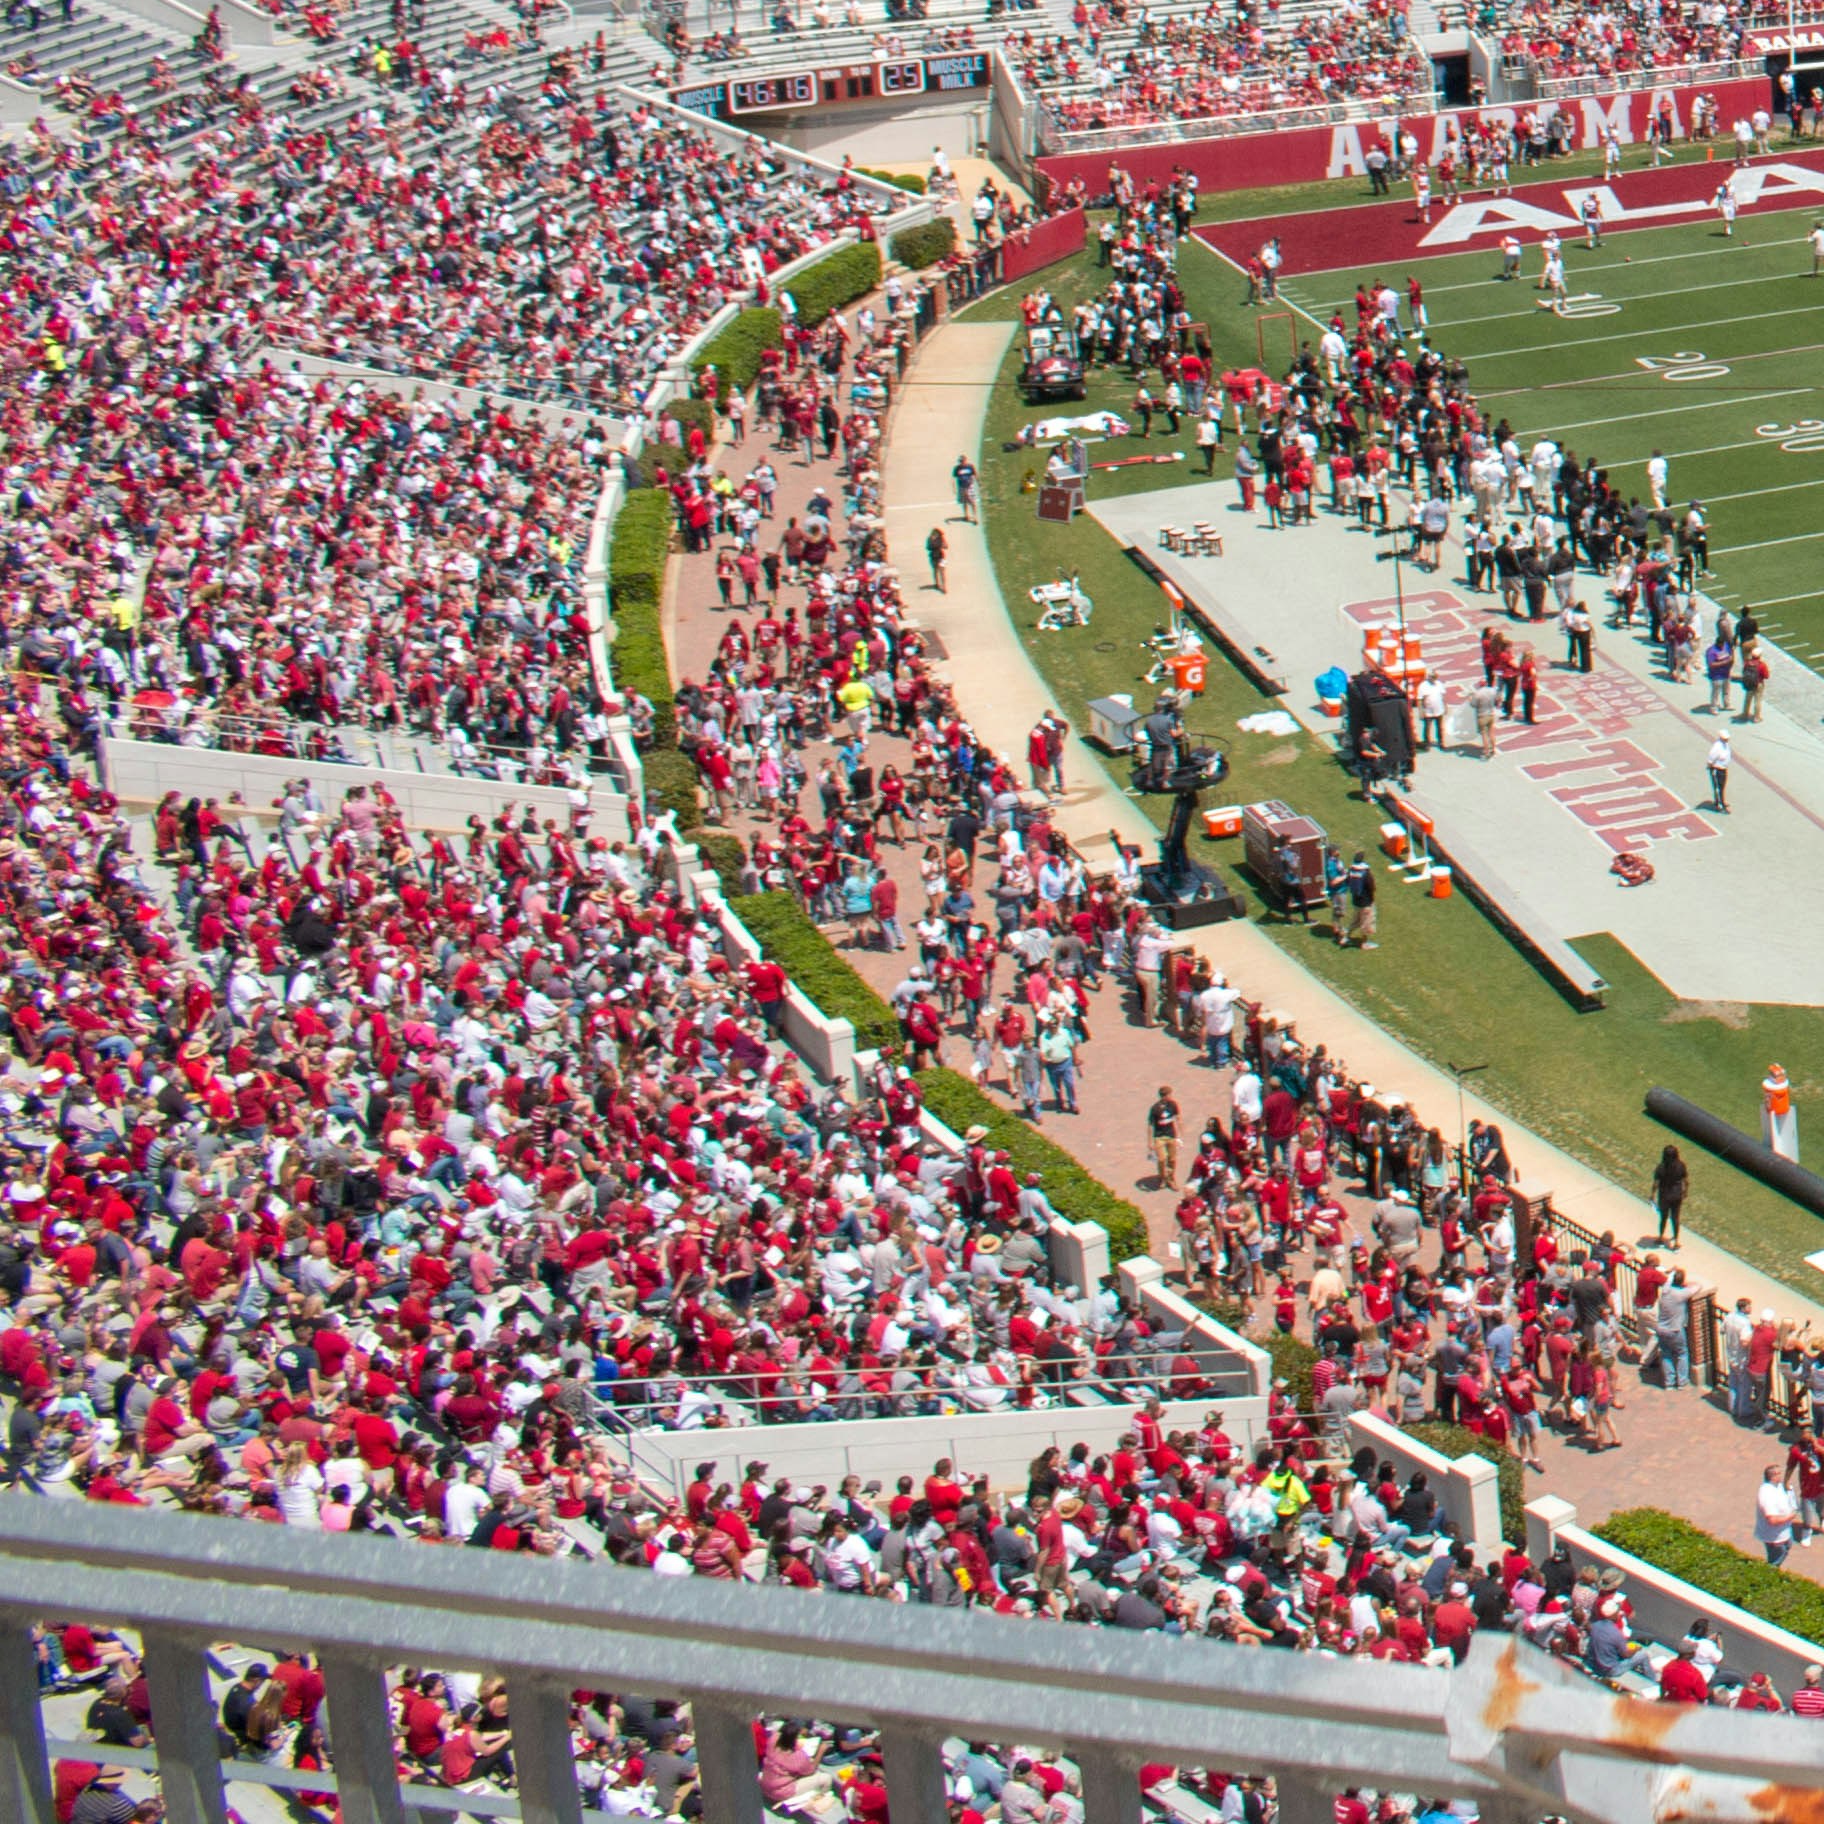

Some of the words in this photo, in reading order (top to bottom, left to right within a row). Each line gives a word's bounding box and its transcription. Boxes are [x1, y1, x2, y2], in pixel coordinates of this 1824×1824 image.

[929, 57, 984, 74] MUSCLE
[887, 67, 918, 89] 25
[940, 74, 975, 89] MILK
[737, 75, 810, 104] 46:16
[1186, 667, 1203, 684] G
[1520, 737, 1723, 856] TIDE
[1224, 820, 1235, 831] G
